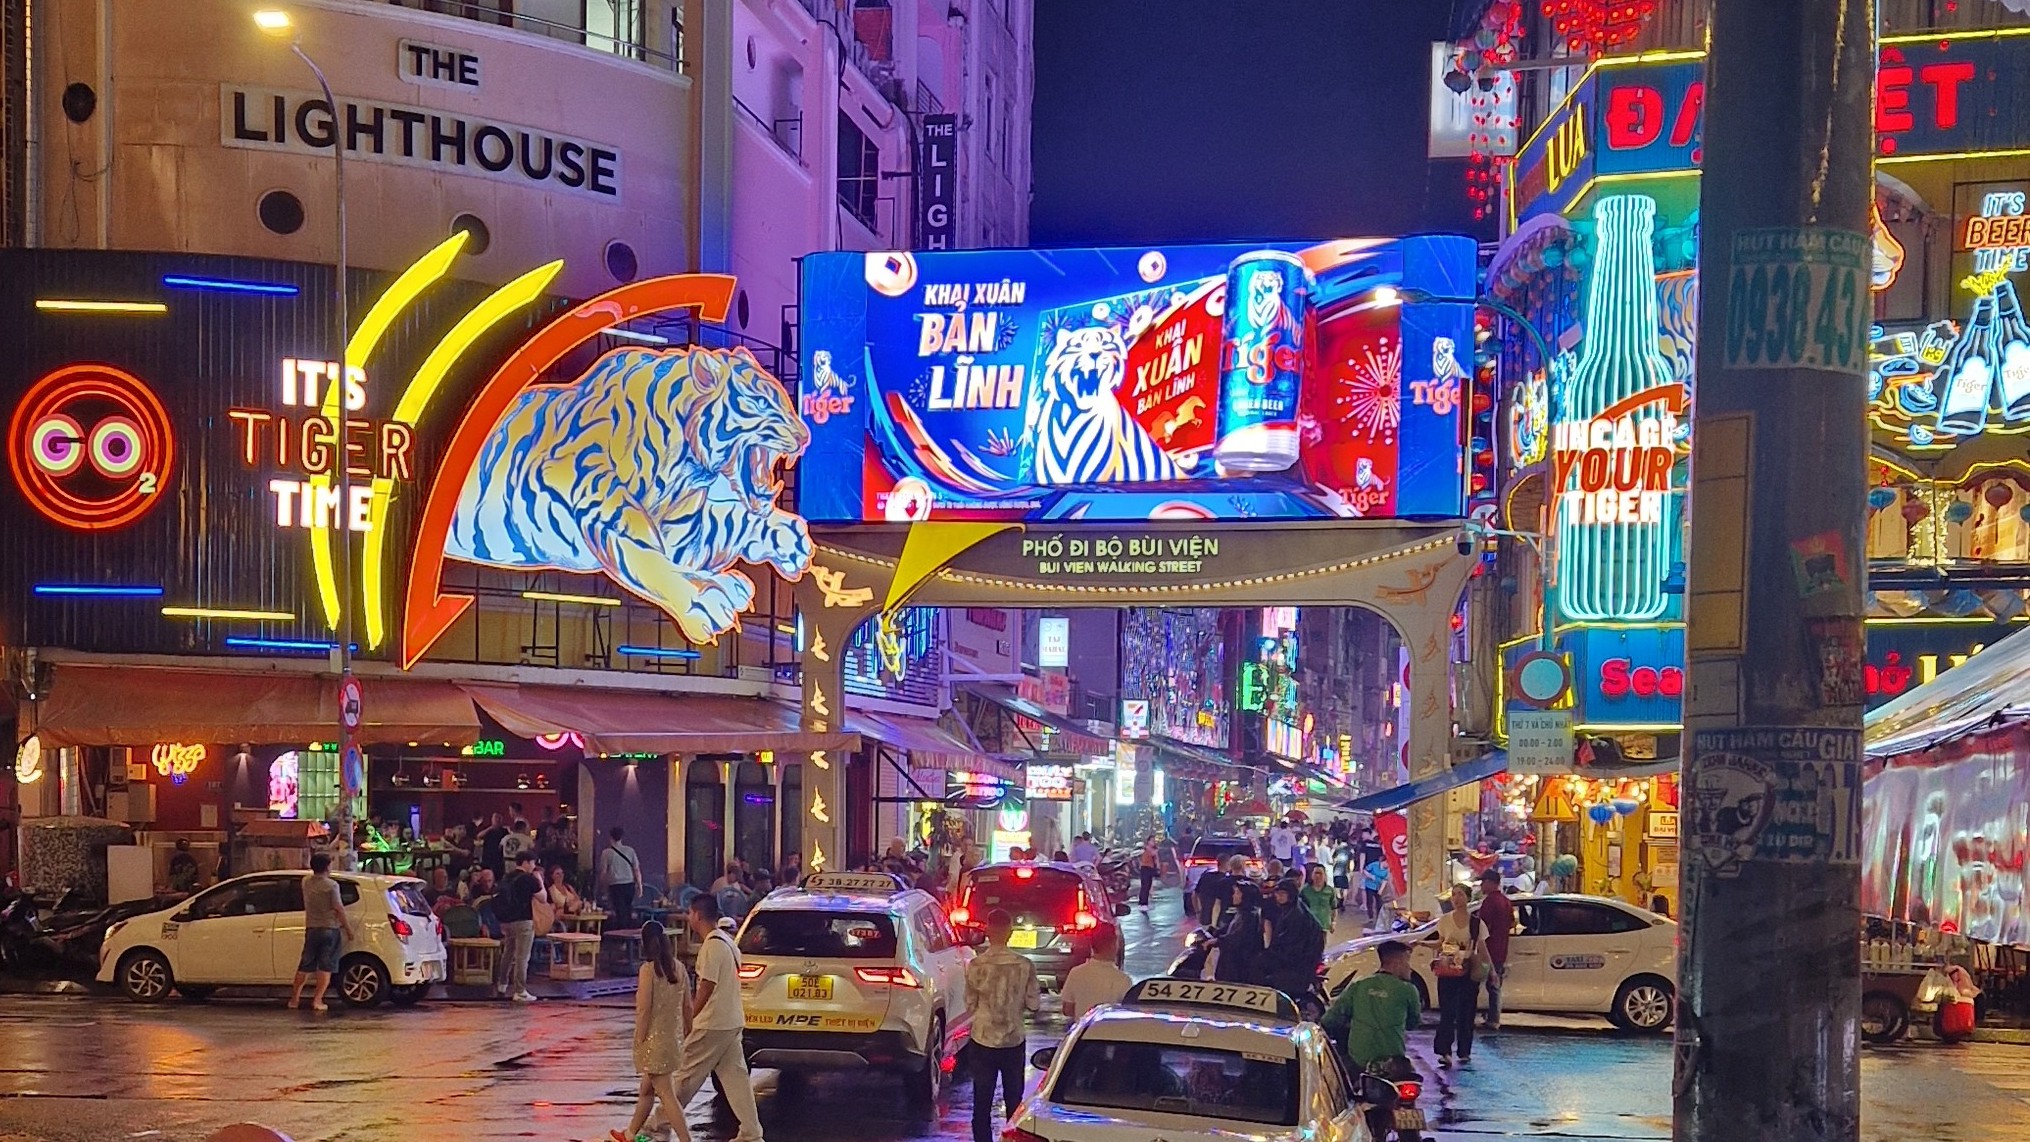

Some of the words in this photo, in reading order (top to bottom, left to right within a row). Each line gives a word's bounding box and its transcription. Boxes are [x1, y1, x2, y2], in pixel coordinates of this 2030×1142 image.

[407, 44, 479, 87] THE
[233, 90, 618, 197] LIGHTHOUSE
[925, 123, 953, 137] THE
[1982, 191, 2026, 217] IT'S
[916, 300, 997, 357] BẢN
[1154, 318, 1188, 350] KHAI
[1131, 331, 1204, 398] XUÂN
[282, 357, 368, 412] IT'S
[927, 355, 1026, 412] LĨNH
[1955, 377, 1988, 394] Tiger
[229, 407, 416, 481] TIGER
[1555, 446, 1675, 495] YOUR
[269, 479, 375, 532] TIME
[1338, 486, 1390, 512] Tiger
[1564, 489, 1664, 526] TIGER
[1021, 533, 1064, 557] PHỐ
[1069, 540, 1089, 557] ĐI
[1095, 535, 1124, 559] BỘ
[1128, 534, 1163, 556] BÙI
[1168, 534, 1220, 559] VIỆN
[1039, 561, 1061, 574] BUI
[1064, 561, 1095, 574] VIEN
[1096, 560, 1157, 574] WALKING
[1158, 560, 1203, 574] STREET
[1147, 983, 1173, 998] 54
[1180, 984, 1206, 1000] 27
[1212, 987, 1239, 1003] 27
[1245, 990, 1272, 1007] 27
[776, 1014, 822, 1027] MPE
